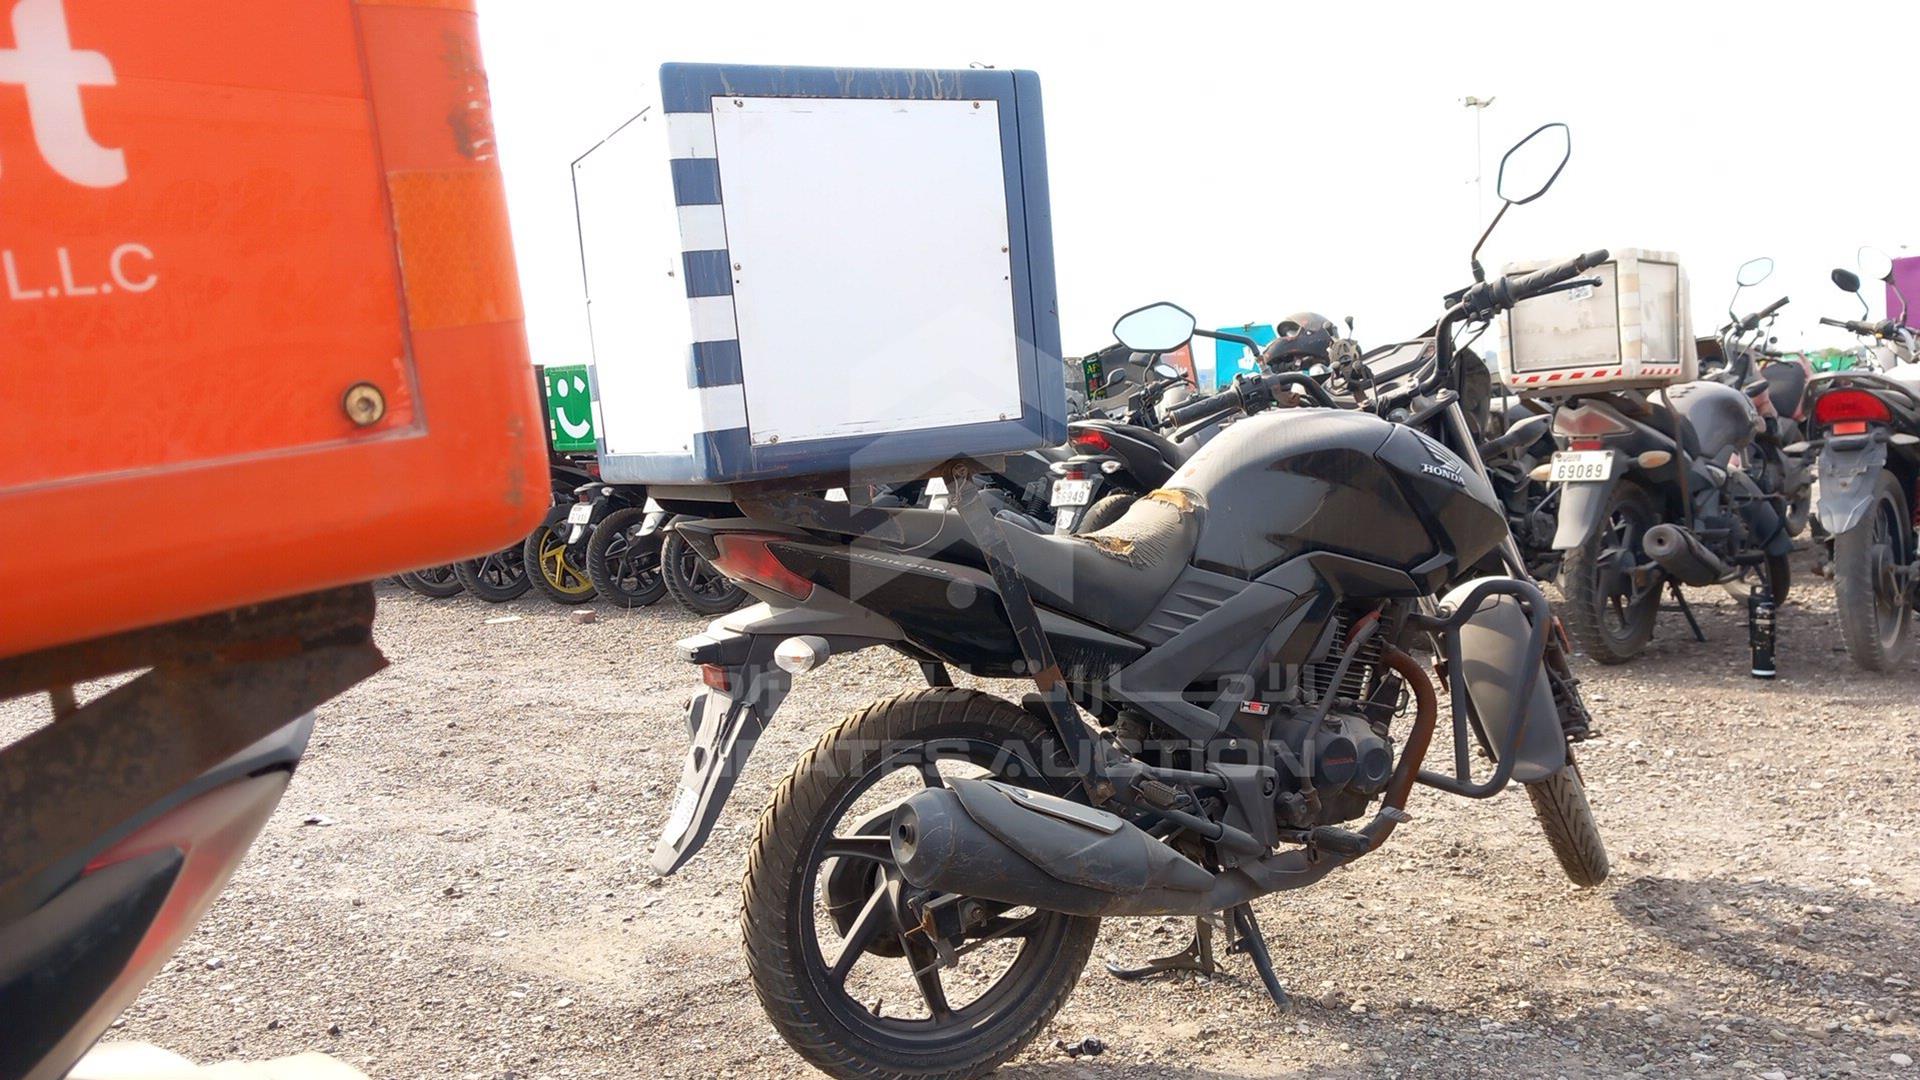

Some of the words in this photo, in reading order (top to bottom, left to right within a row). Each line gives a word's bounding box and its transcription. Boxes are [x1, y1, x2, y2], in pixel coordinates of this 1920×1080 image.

[3, 243, 158, 300] L.L.C
[1421, 463, 1466, 486] HONDA
[1558, 464, 1603, 479] 69089
